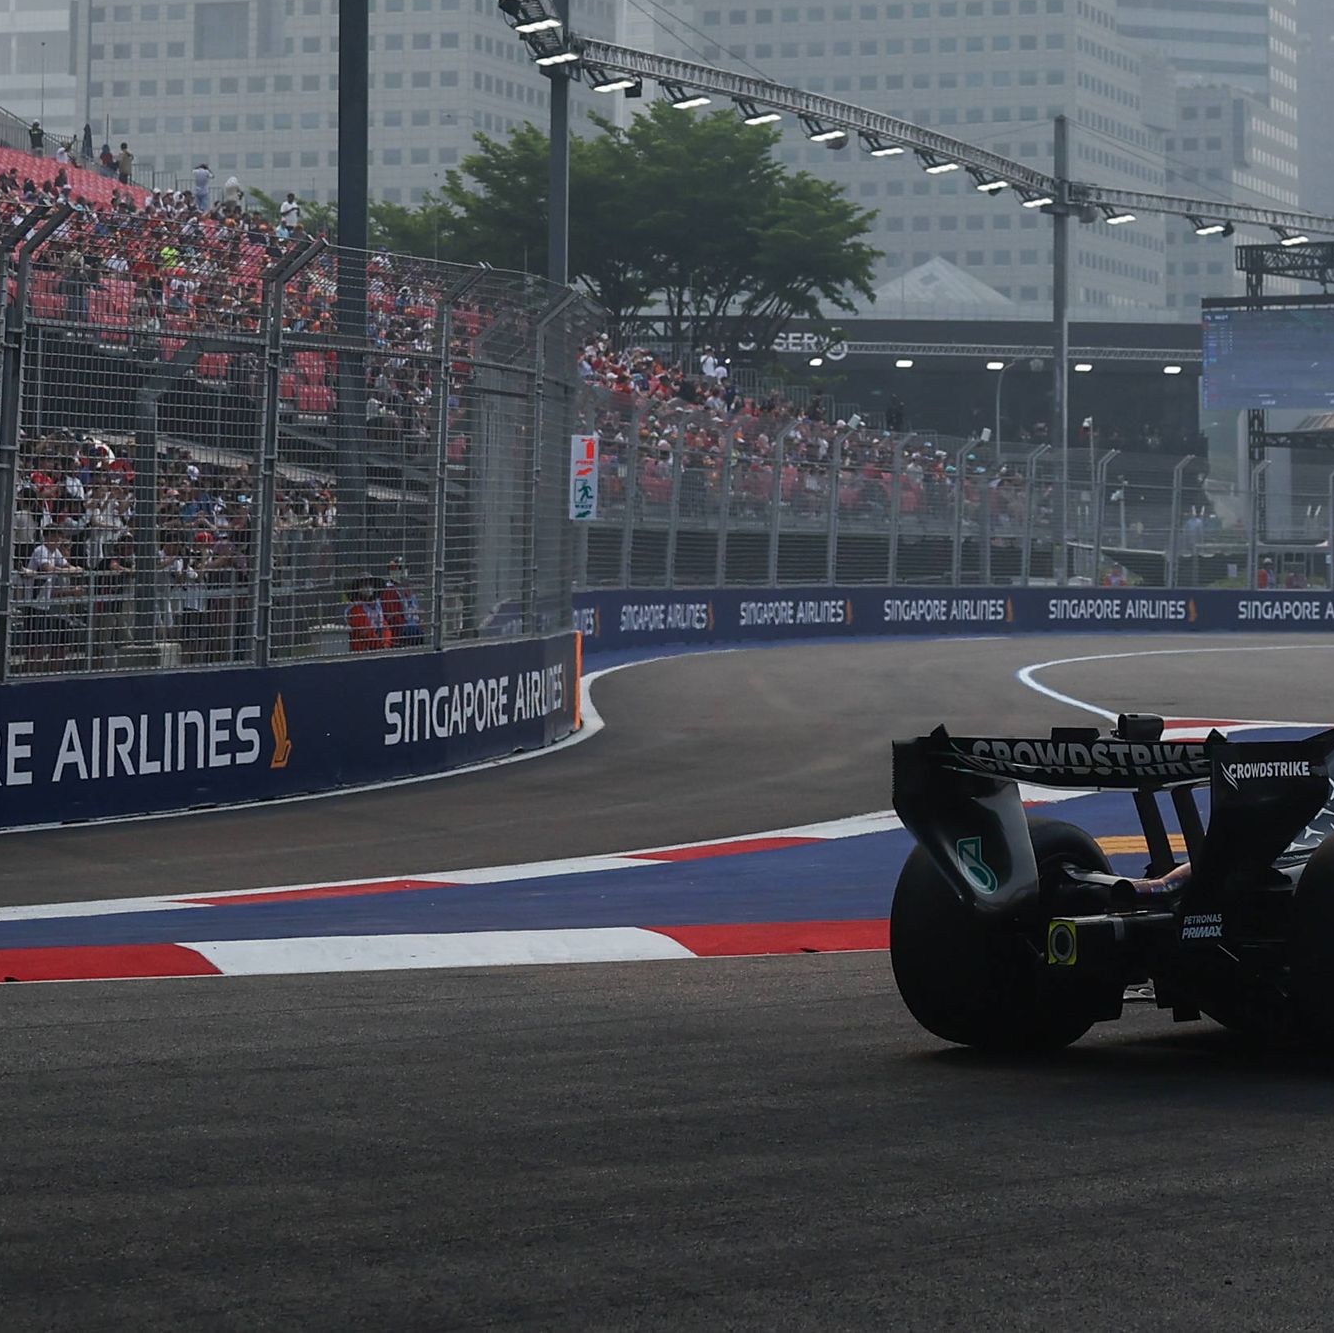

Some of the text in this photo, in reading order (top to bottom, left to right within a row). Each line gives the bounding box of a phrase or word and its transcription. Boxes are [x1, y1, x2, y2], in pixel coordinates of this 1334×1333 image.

[620, 604, 666, 632] SINGAPORE
[740, 600, 844, 626] SINGAPORE AIRLINES
[884, 599, 1004, 621] SINGAPORE AIRLINES
[1049, 599, 1186, 620] SINGAPORE AIRLINES
[1238, 600, 1320, 620] SINGAPORE
[384, 676, 509, 745] SINGAPORE
[52, 705, 261, 783] AIRLINES
[971, 739, 1207, 777] CROWDSTRIKE
[1229, 761, 1311, 780] CROWDSTRIKE
[1183, 913, 1223, 925] PETRONAS
[1181, 924, 1223, 941] PRIMAX
